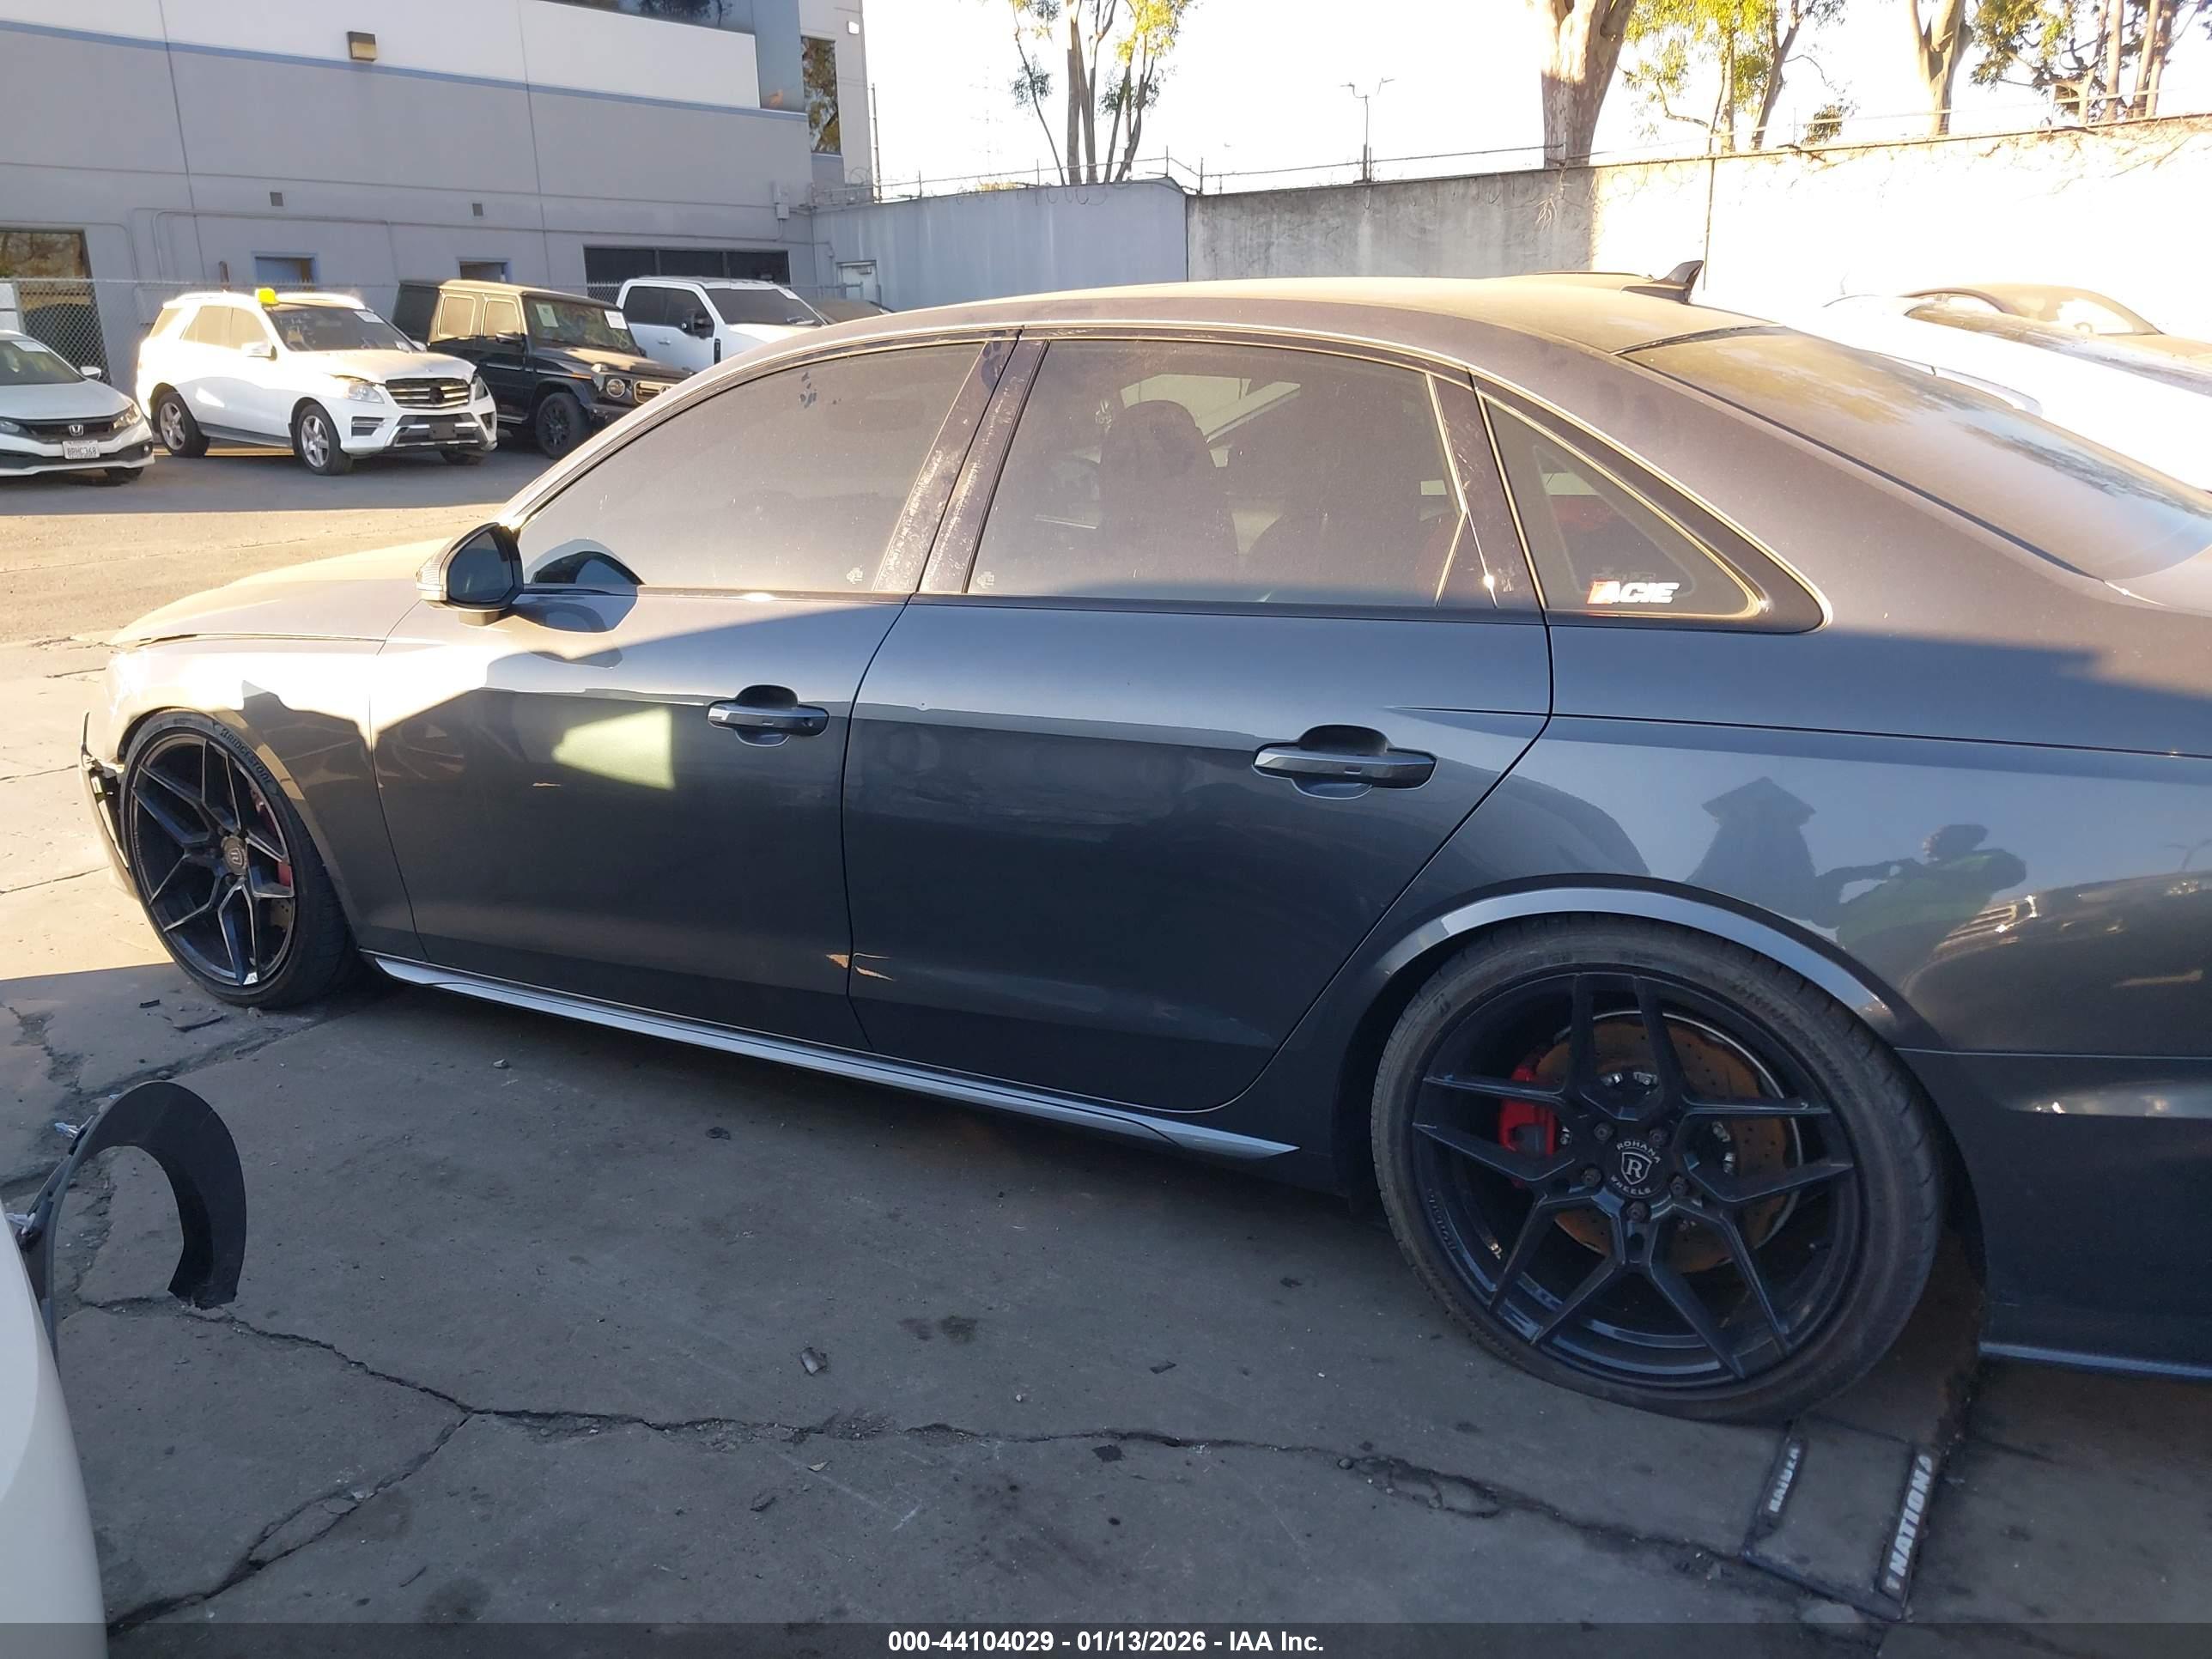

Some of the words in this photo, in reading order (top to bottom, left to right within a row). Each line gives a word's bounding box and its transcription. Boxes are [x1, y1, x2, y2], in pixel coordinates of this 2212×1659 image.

[1616, 1140, 1661, 1164] ROHANA
[1625, 1158, 1642, 1179] R
[1611, 1175, 1650, 1195] WHEELS
[1889, 1469, 1930, 1577] NATION
